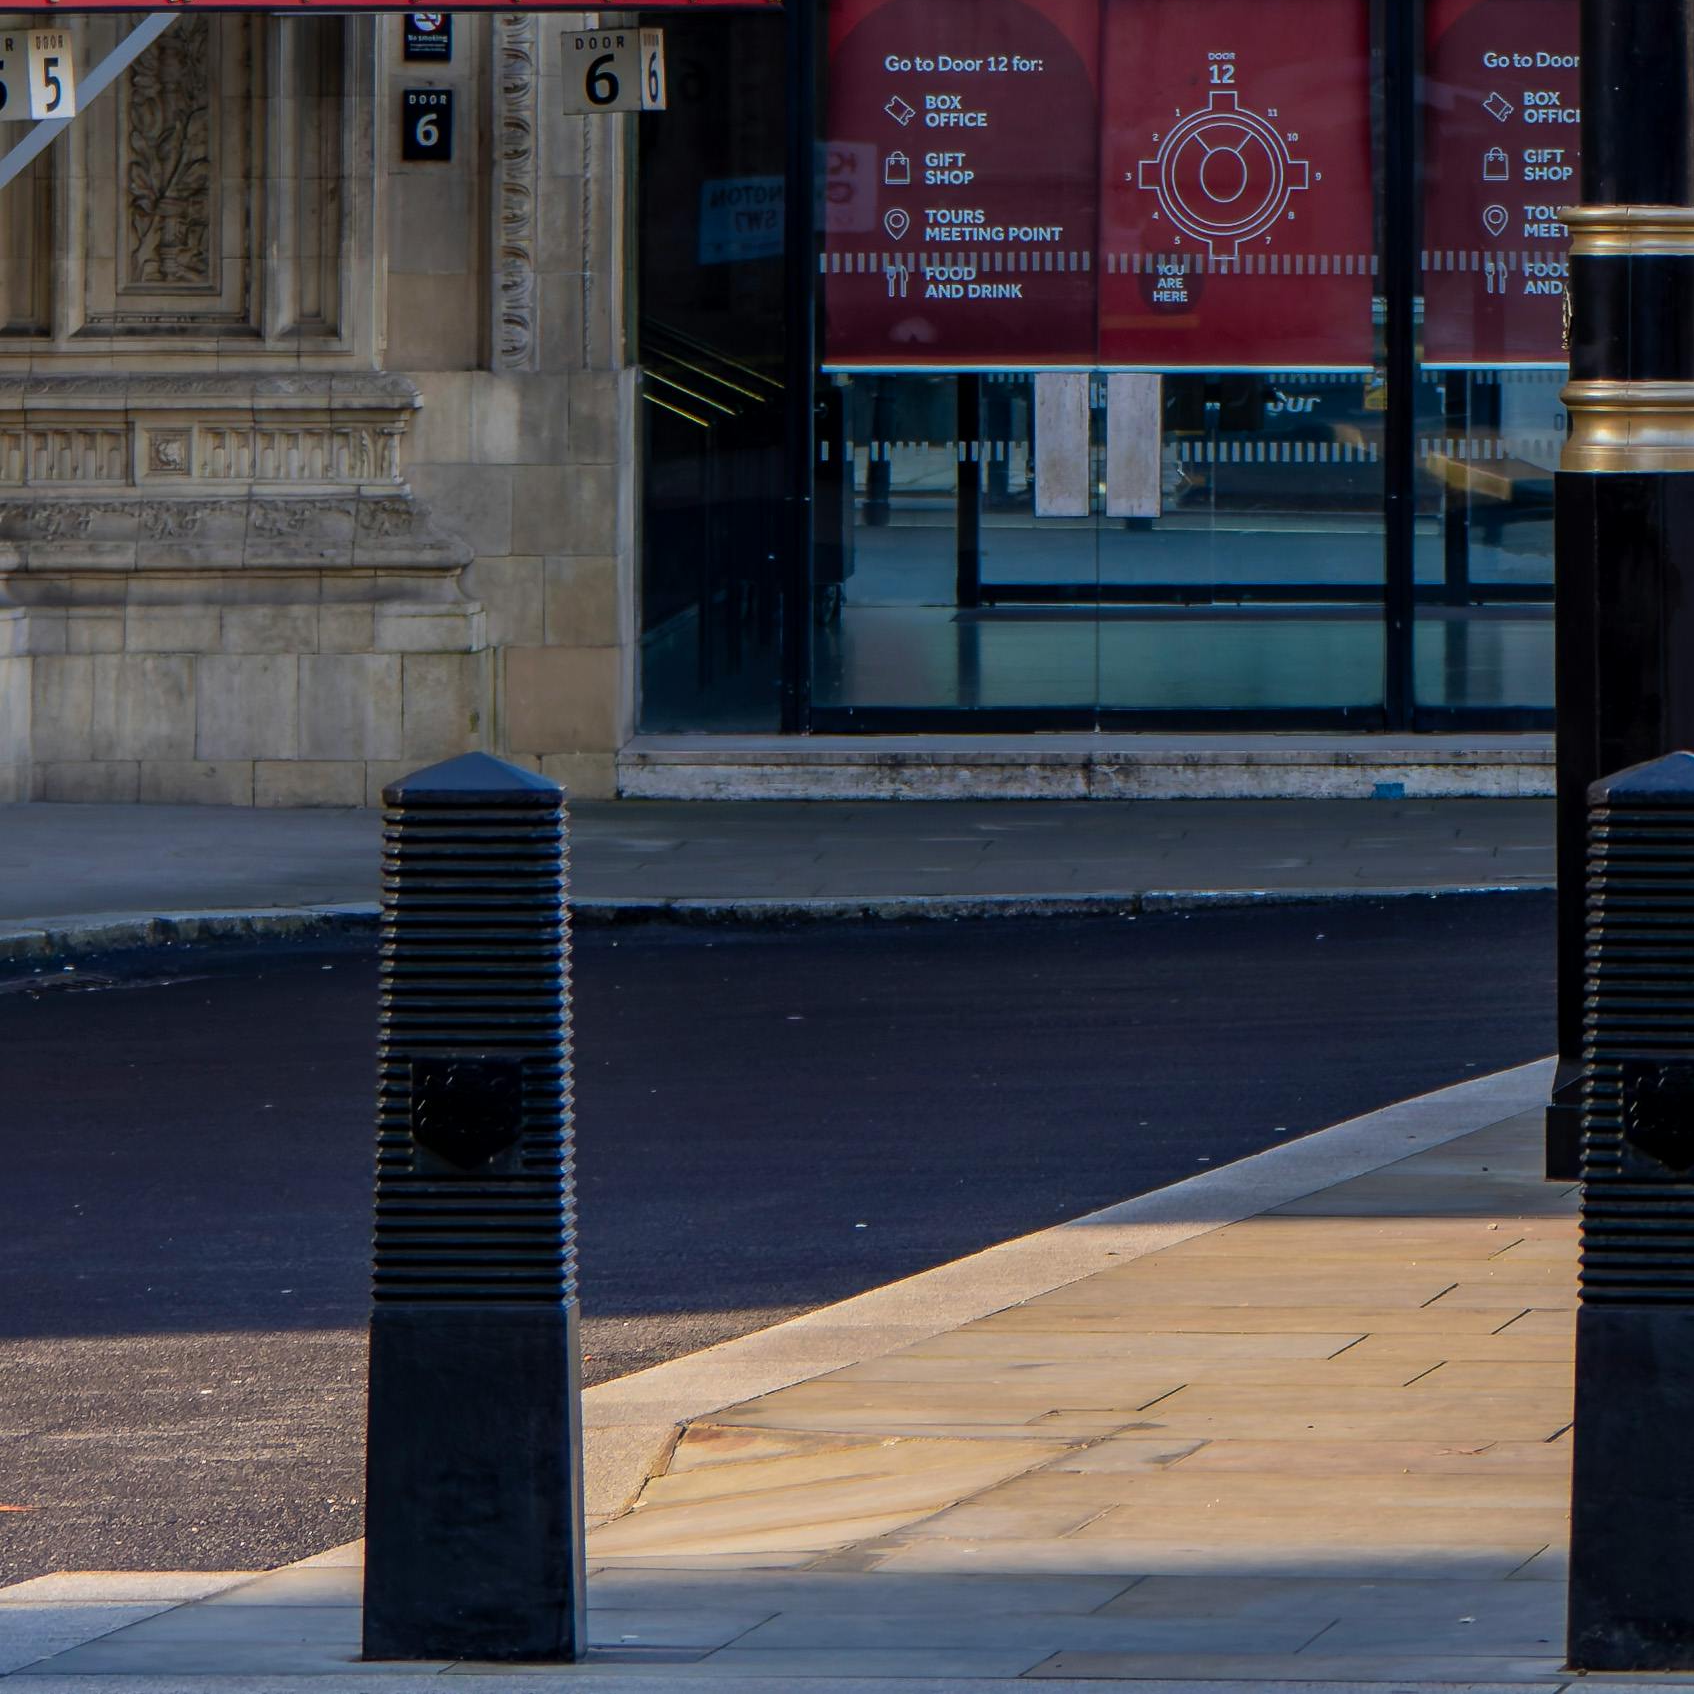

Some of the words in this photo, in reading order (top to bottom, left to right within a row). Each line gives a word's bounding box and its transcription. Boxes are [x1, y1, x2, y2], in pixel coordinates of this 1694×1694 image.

[575, 36, 625, 50] DOOR
[1208, 52, 1235, 60] DOOR
[1483, 52, 1510, 68] Go
[1513, 54, 1532, 68] to
[1536, 52, 1580, 68] Door
[884, 55, 911, 72] Go
[914, 57, 934, 72] to
[938, 55, 983, 72] Door
[987, 57, 1008, 72] 12
[1012, 55, 1044, 72] for:
[586, 53, 620, 105] 6
[648, 52, 658, 103] 6
[1209, 65, 1235, 83] 12
[43, 57, 62, 113] 5
[409, 95, 447, 105] DOOR
[925, 95, 962, 110] BOX
[1524, 92, 1560, 106] BOX
[925, 112, 988, 127] OFFICE
[416, 113, 439, 146] 6
[925, 153, 966, 167] GIFT
[1524, 149, 1564, 163] GIFT
[925, 170, 974, 185] SHOP
[1524, 166, 1573, 181] SHOP
[925, 210, 985, 224] TOURS
[925, 227, 1005, 241] MEETING
[1008, 227, 1063, 241] POINT
[1524, 224, 1569, 238] MEET
[925, 267, 976, 280] FOOD
[1157, 264, 1184, 275] YOU
[1157, 278, 1184, 289] ARE
[1524, 280, 1562, 294] AND
[925, 284, 964, 298] AND
[968, 284, 1022, 298] DRINK
[1153, 291, 1188, 302] HERE
